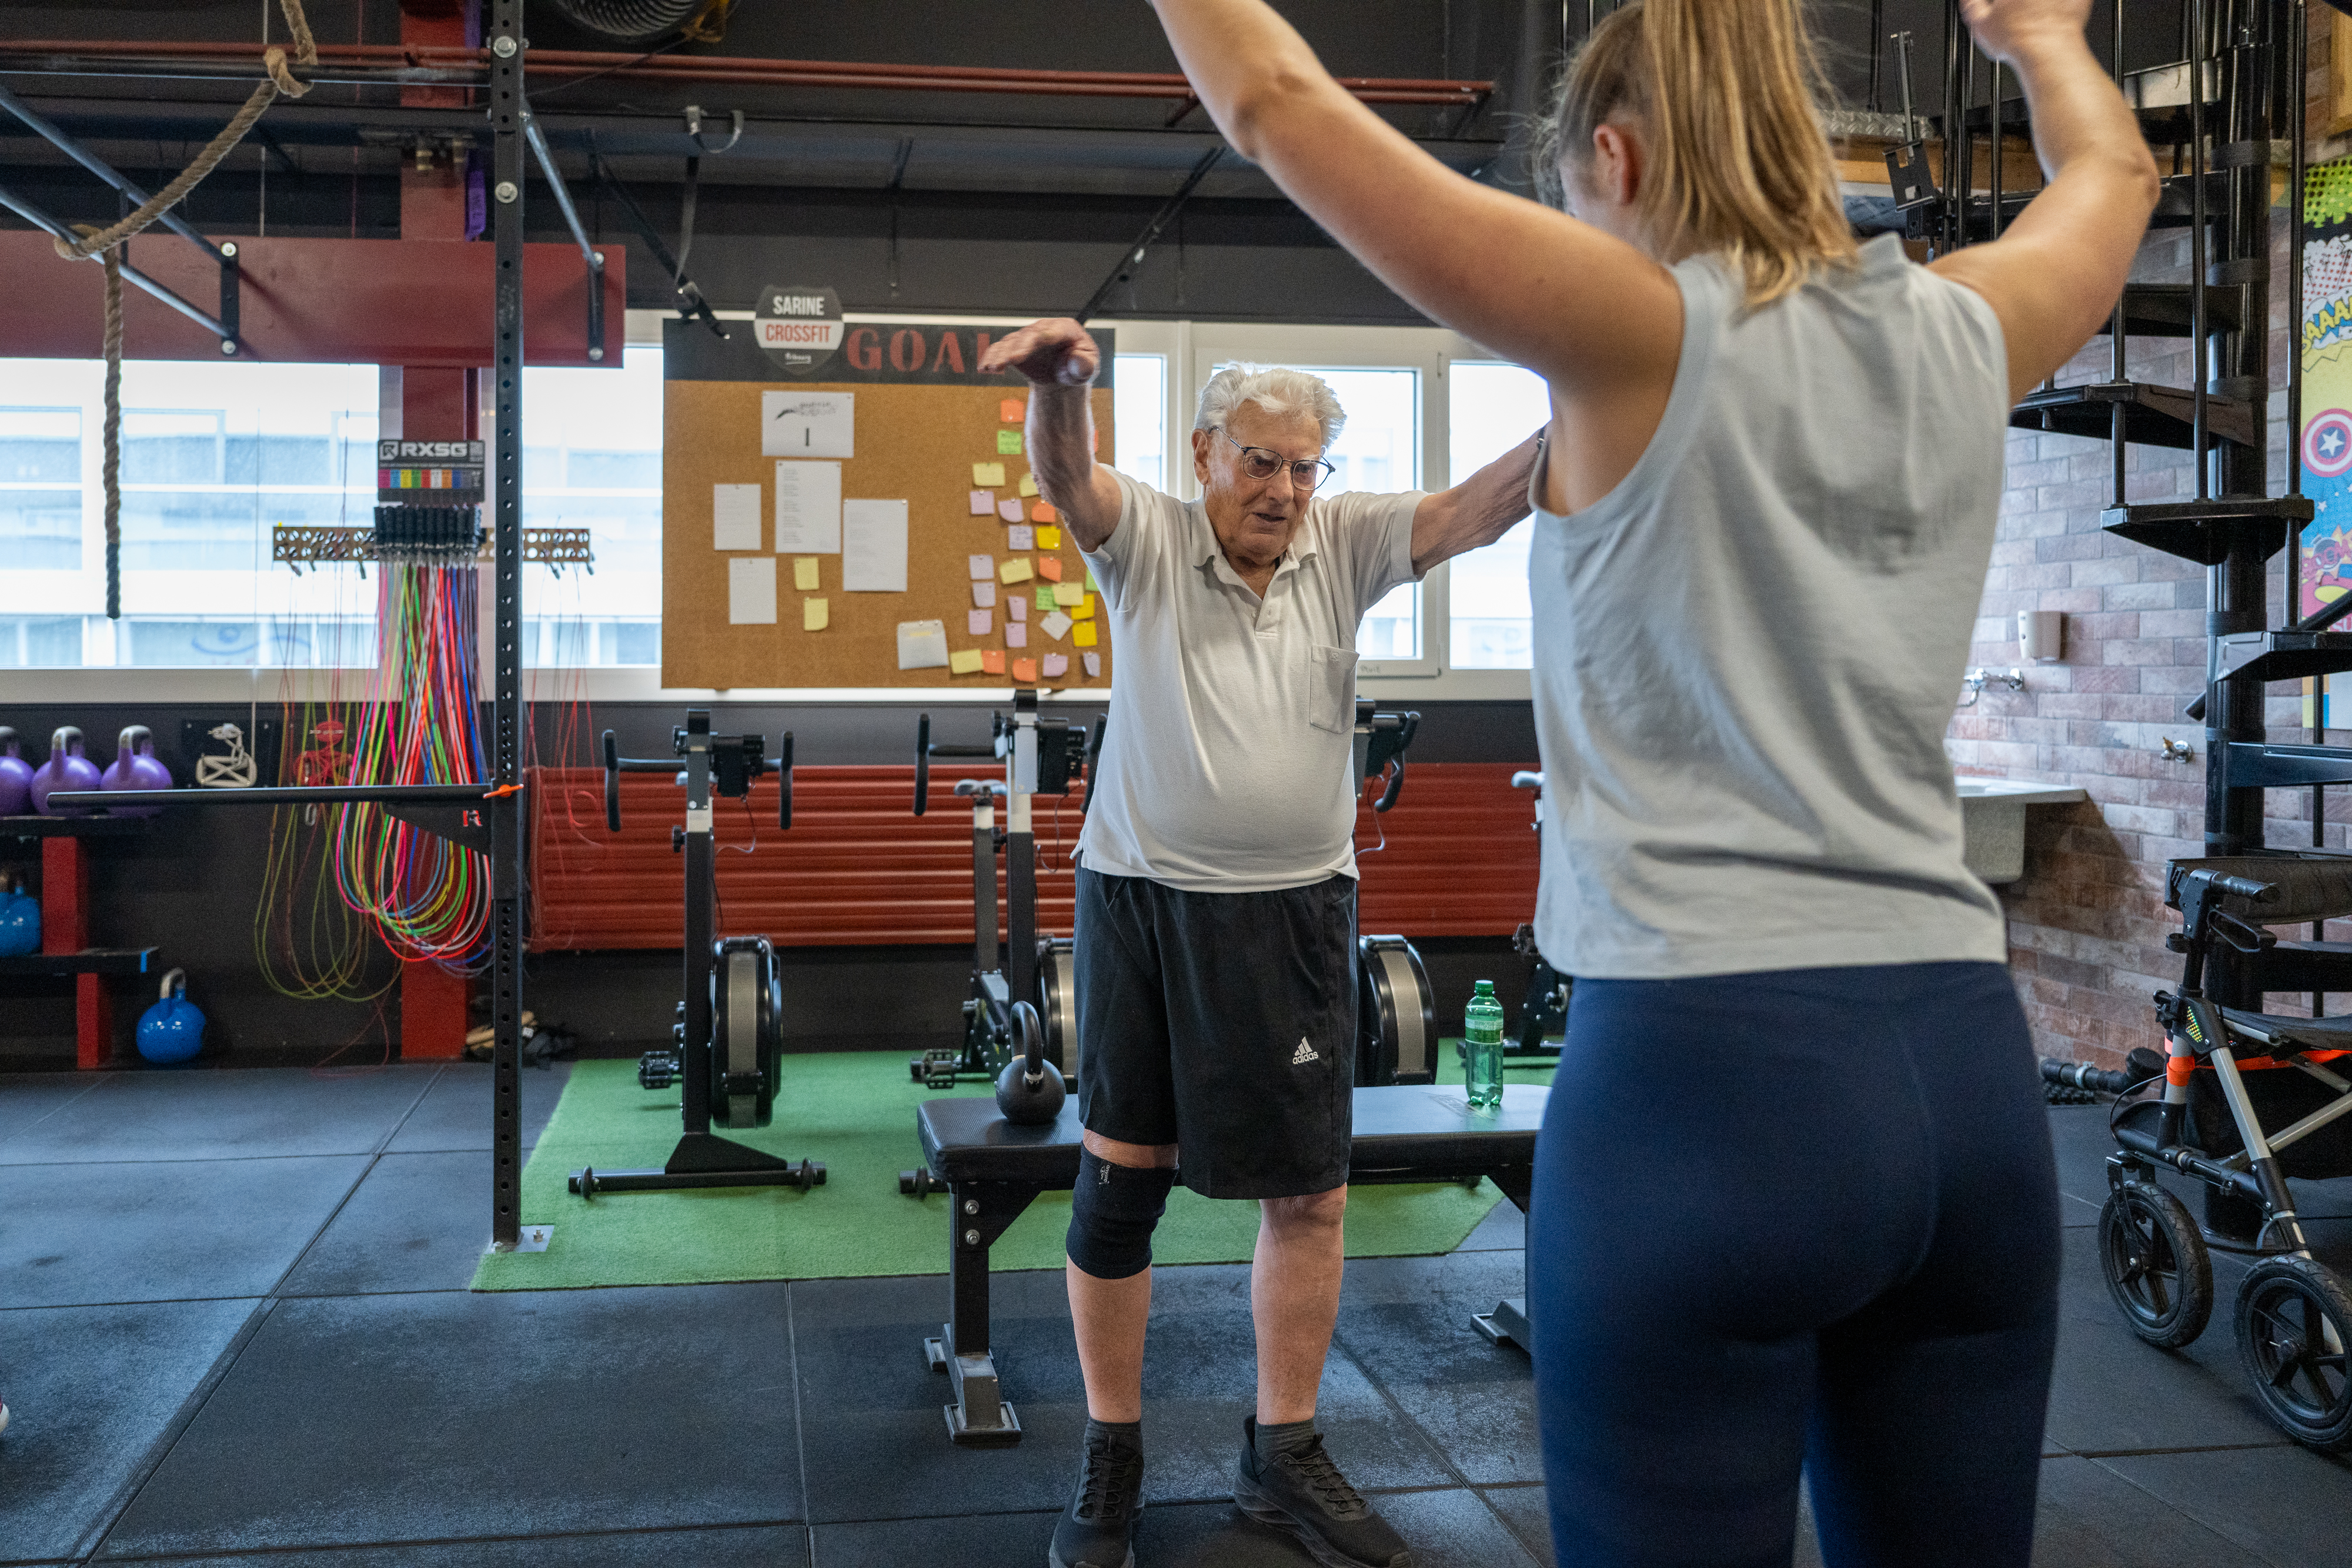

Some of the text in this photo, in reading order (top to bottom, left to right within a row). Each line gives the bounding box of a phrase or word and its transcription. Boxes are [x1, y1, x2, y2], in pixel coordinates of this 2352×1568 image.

[773, 296, 824, 315] SARINE
[766, 324, 830, 342] CROSSFIT
[400, 442, 467, 457] RXSG
[1292, 1051, 1318, 1064] adidas
